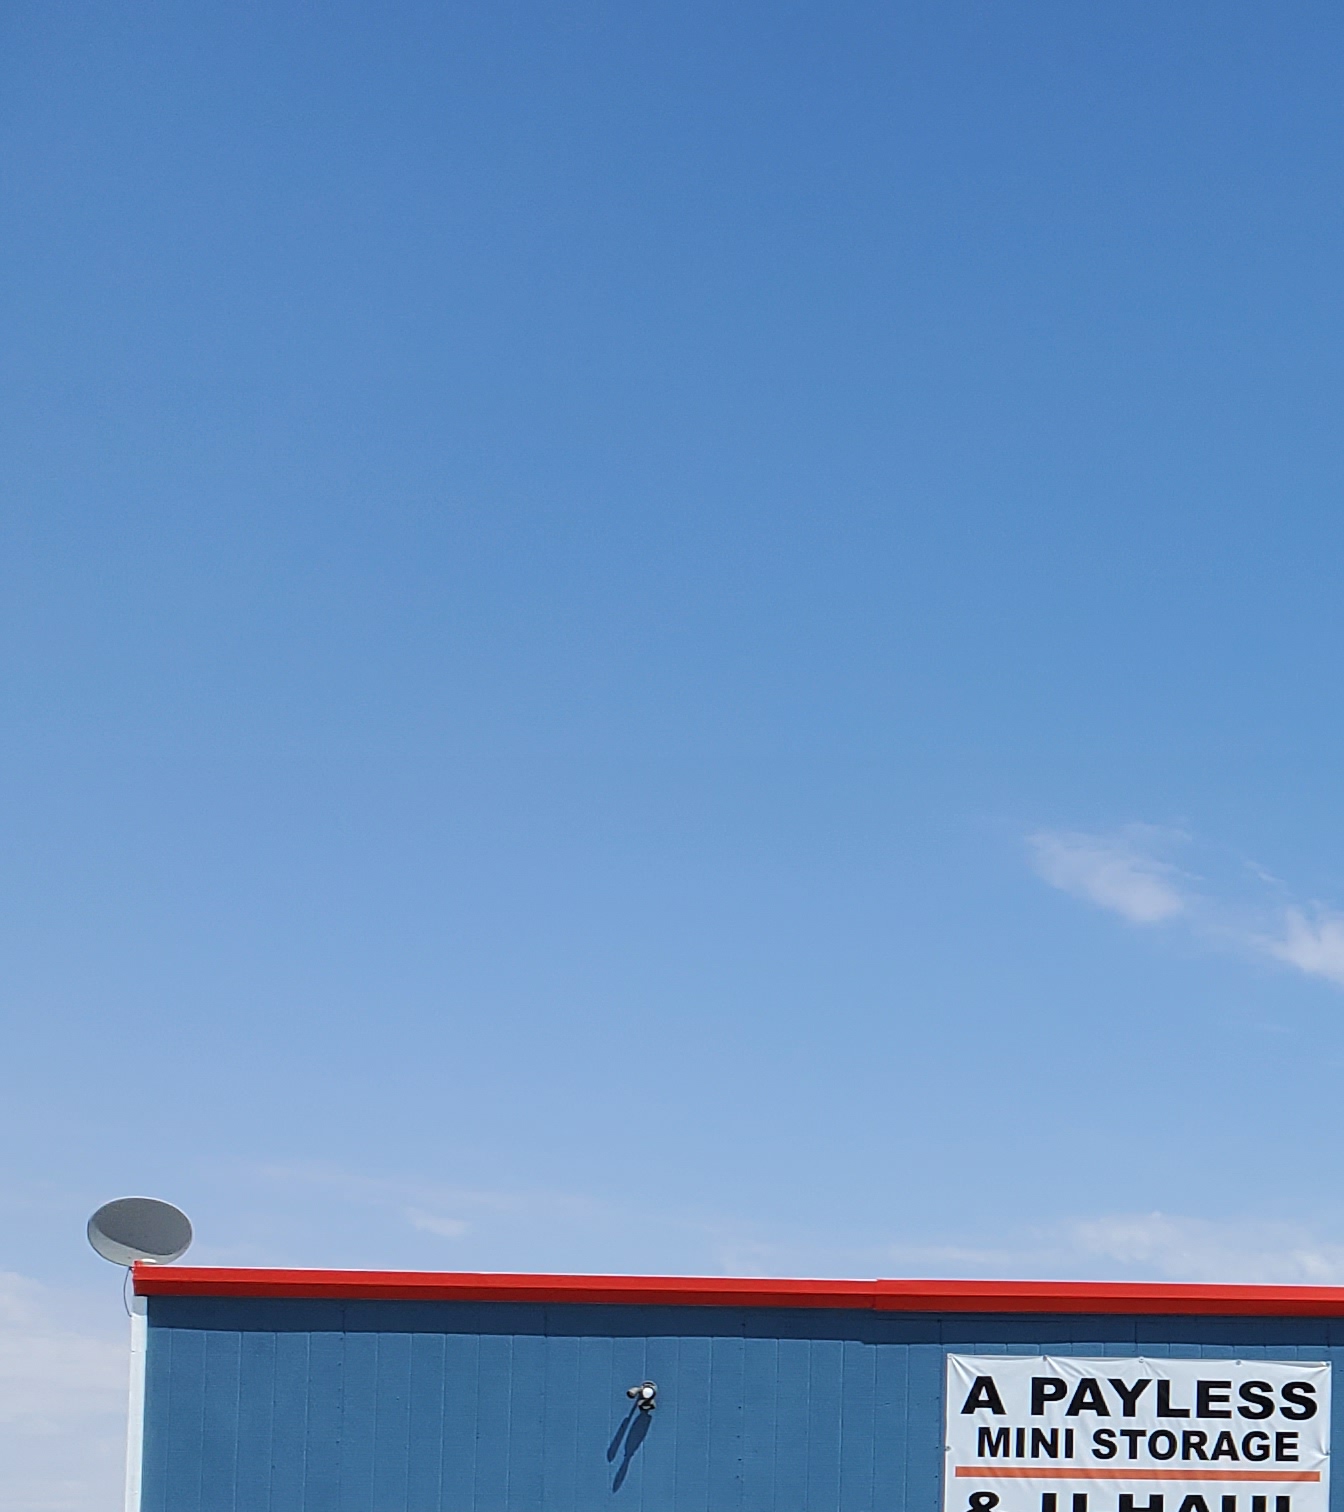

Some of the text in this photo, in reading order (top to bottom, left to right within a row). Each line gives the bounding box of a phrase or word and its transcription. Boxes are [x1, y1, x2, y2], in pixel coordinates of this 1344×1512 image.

[961, 1375, 1318, 1420] A PAYLESS
[978, 1426, 1299, 1462] MINI STORAGE
